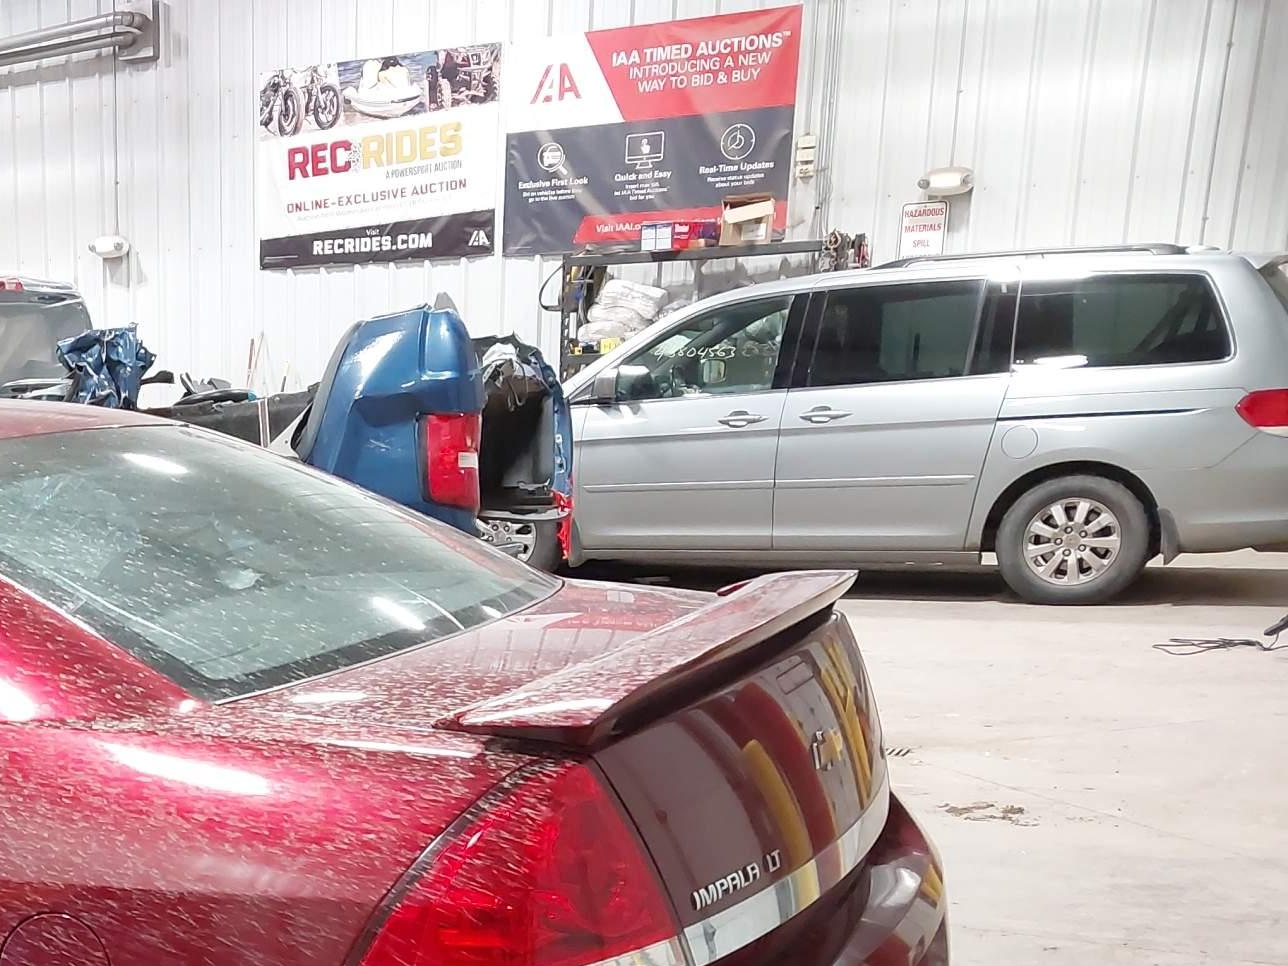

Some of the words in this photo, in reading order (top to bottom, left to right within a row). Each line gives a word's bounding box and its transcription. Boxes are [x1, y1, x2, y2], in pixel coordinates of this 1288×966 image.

[613, 49, 639, 67] IAA
[644, 43, 691, 63] TIMED
[629, 59, 720, 80] INTRODUCING
[724, 57, 734, 68] A
[739, 51, 772, 66] NEW
[638, 78, 666, 93] WAY
[670, 76, 687, 89] TO
[691, 73, 713, 87] BID
[717, 71, 727, 83] &
[732, 67, 761, 82] BUY
[287, 139, 353, 180] REC
[360, 121, 463, 170] RIDES
[391, 164, 432, 179] POWERSPORT
[434, 160, 462, 172] AUCTION
[740, 161, 775, 171] Updates
[518, 180, 551, 190] Exclusive
[551, 178, 568, 187] First
[569, 176, 589, 186] Look
[614, 173, 637, 181] Quick
[638, 170, 653, 180] and
[654, 169, 672, 179] Easy
[287, 187, 407, 214] ONLINE-EXCLUSIVE
[412, 179, 467, 196] AUCTION
[904, 207, 945, 218] HAZARDOUS
[365, 228, 380, 236] Visit
[596, 223, 614, 233] Visit
[904, 223, 942, 233] MATERIALS
[313, 232, 433, 255] RECRIDES.COM
[912, 239, 930, 248] SPILL
[692, 862, 760, 911] IMPALA
[765, 849, 781, 873] LT
